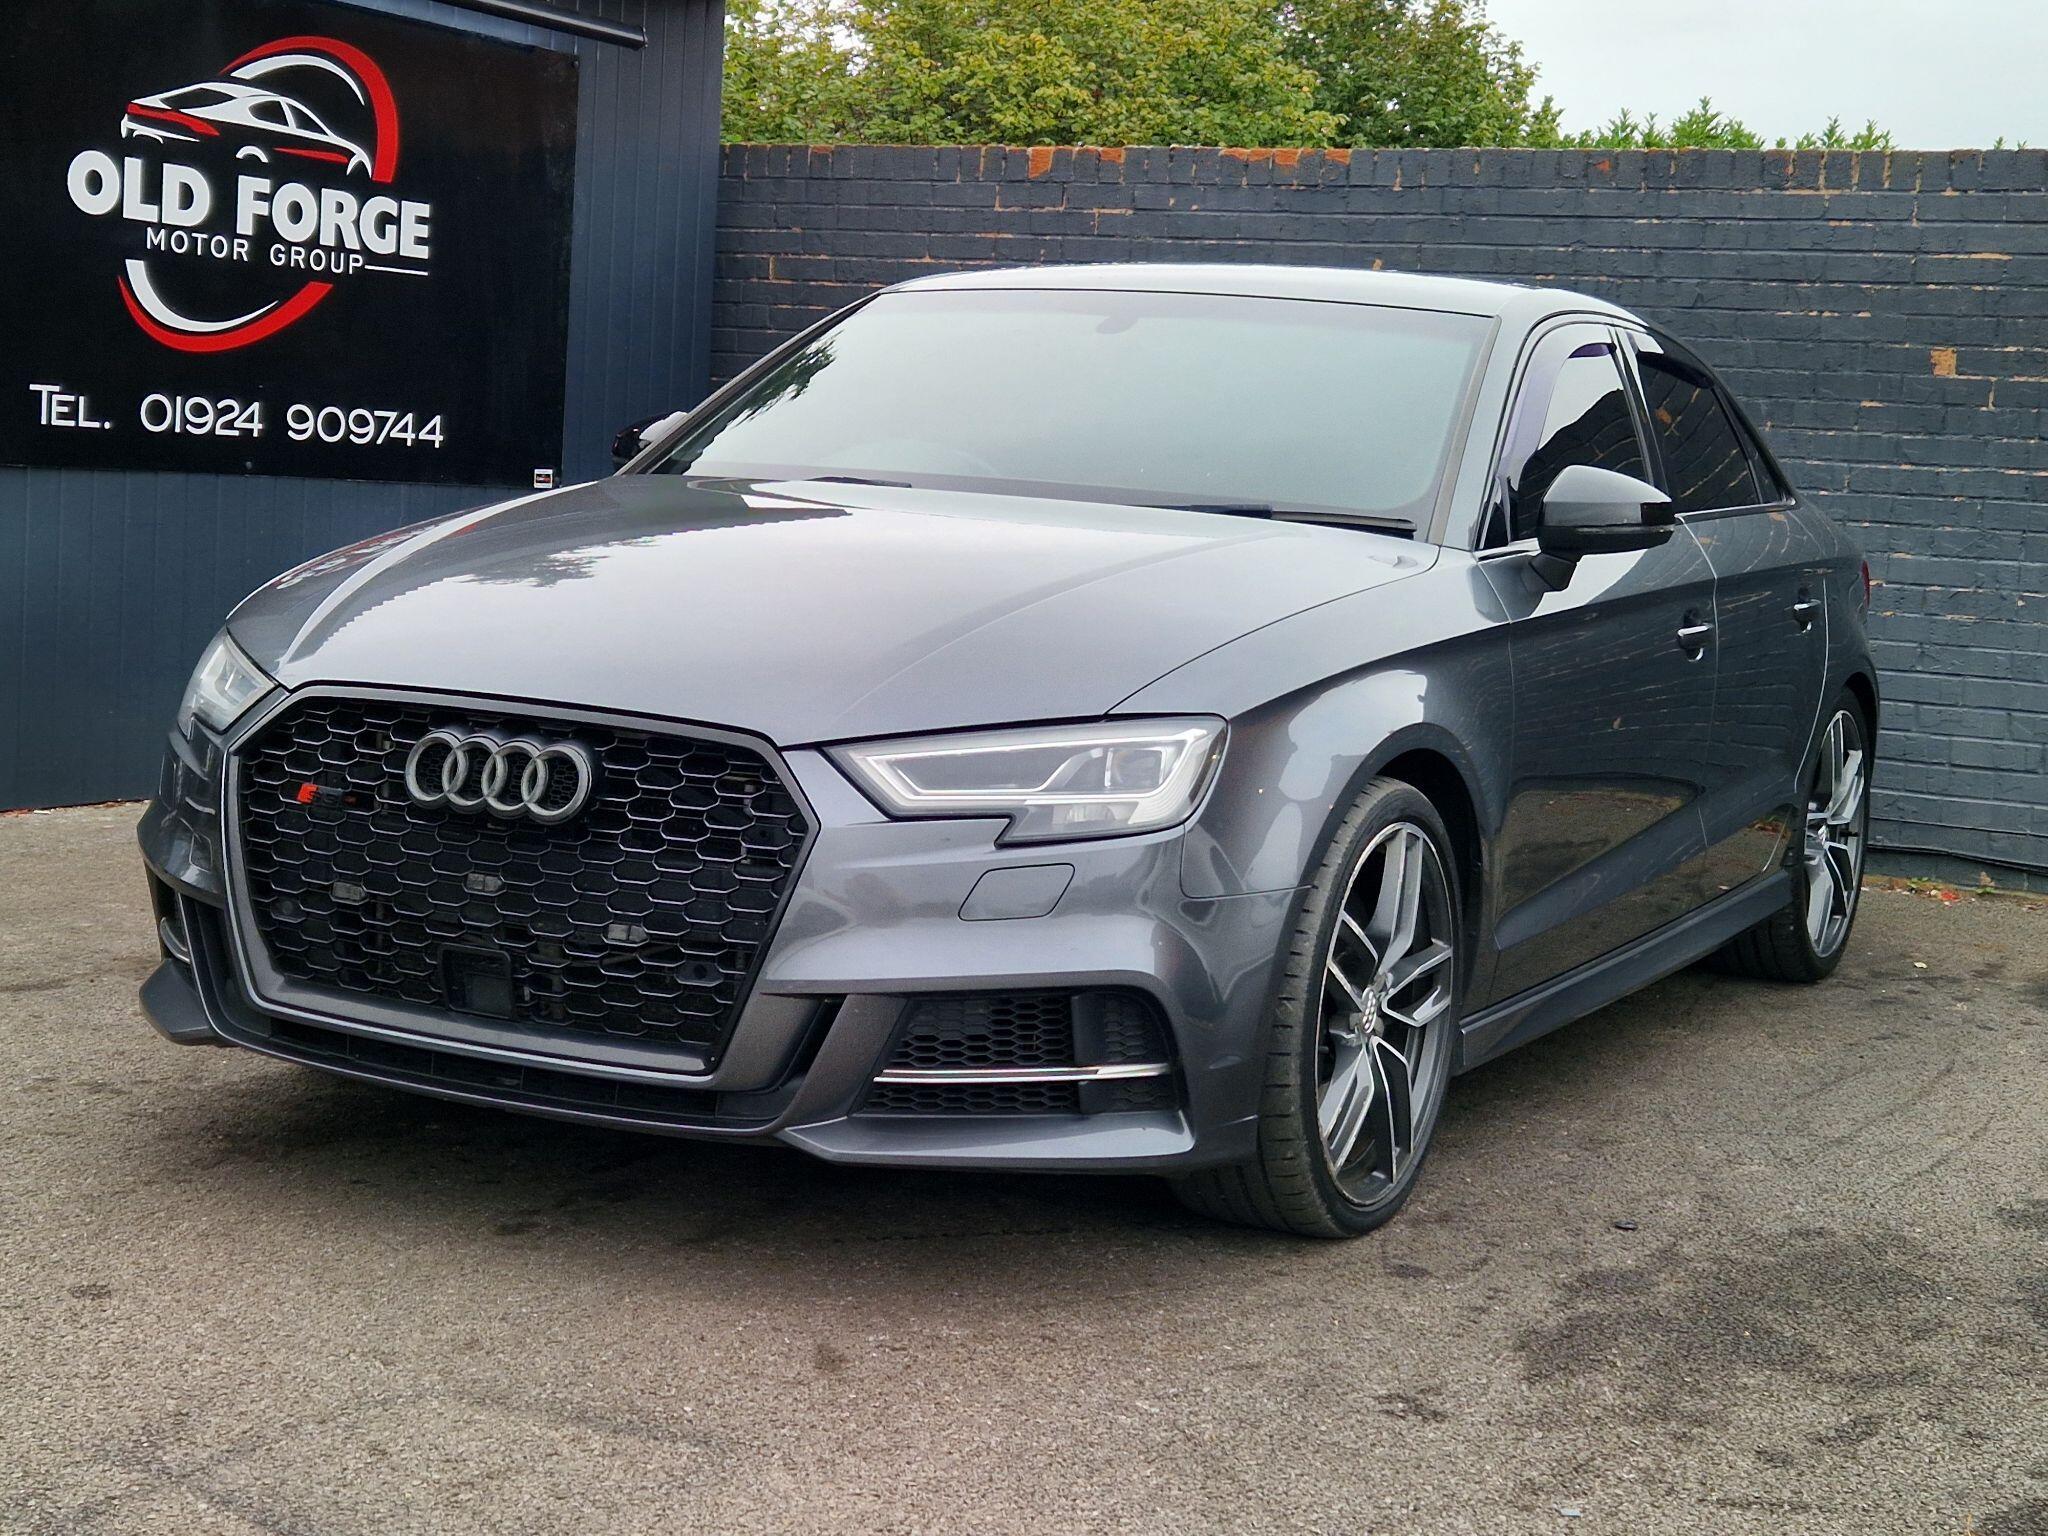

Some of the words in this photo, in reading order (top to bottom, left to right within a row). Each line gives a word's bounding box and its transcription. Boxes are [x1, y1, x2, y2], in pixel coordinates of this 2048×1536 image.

[66, 149, 212, 228] OLD
[236, 174, 431, 260] FORGE
[145, 226, 250, 263] MOTOR
[269, 243, 365, 276] GROUP
[140, 393, 264, 439] 01924
[286, 403, 445, 449] 909744
